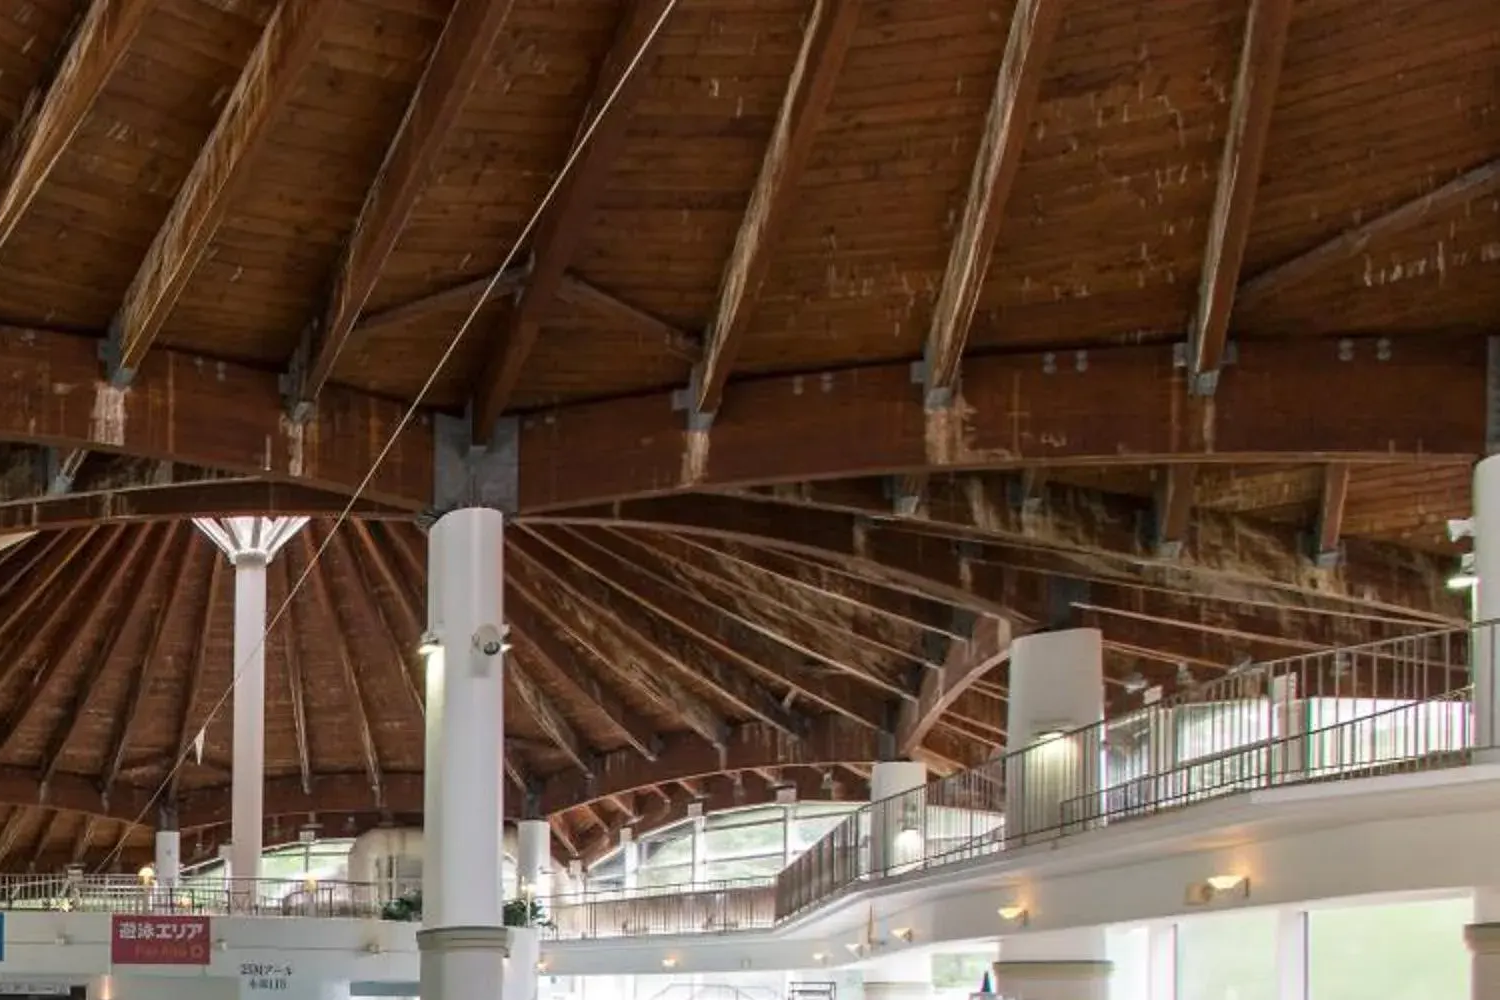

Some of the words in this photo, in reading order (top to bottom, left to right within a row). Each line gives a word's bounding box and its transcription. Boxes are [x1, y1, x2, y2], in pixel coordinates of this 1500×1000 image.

[119, 921, 204, 940] 遊泳エリア
